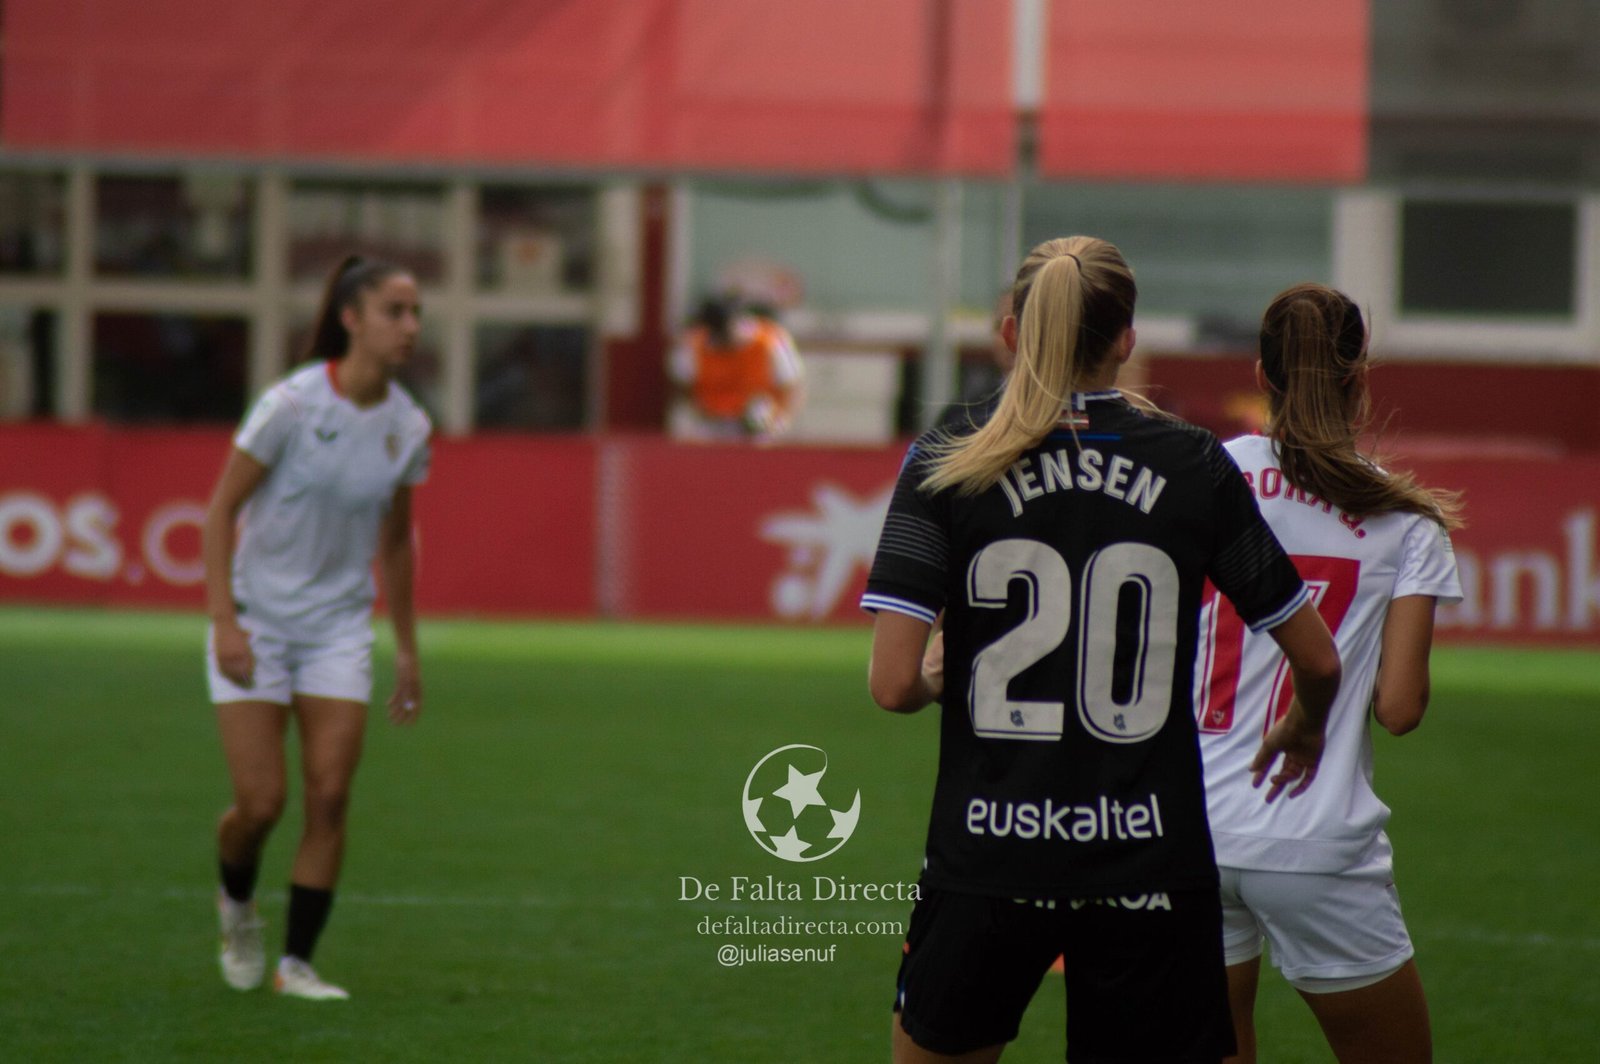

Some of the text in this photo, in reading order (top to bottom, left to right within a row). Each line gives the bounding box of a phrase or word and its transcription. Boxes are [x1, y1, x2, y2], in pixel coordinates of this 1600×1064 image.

[997, 448, 1168, 518] JENSEN
[966, 538, 1180, 744] 20
[1198, 554, 1361, 741] 17
[967, 793, 1164, 842] euskaltel
